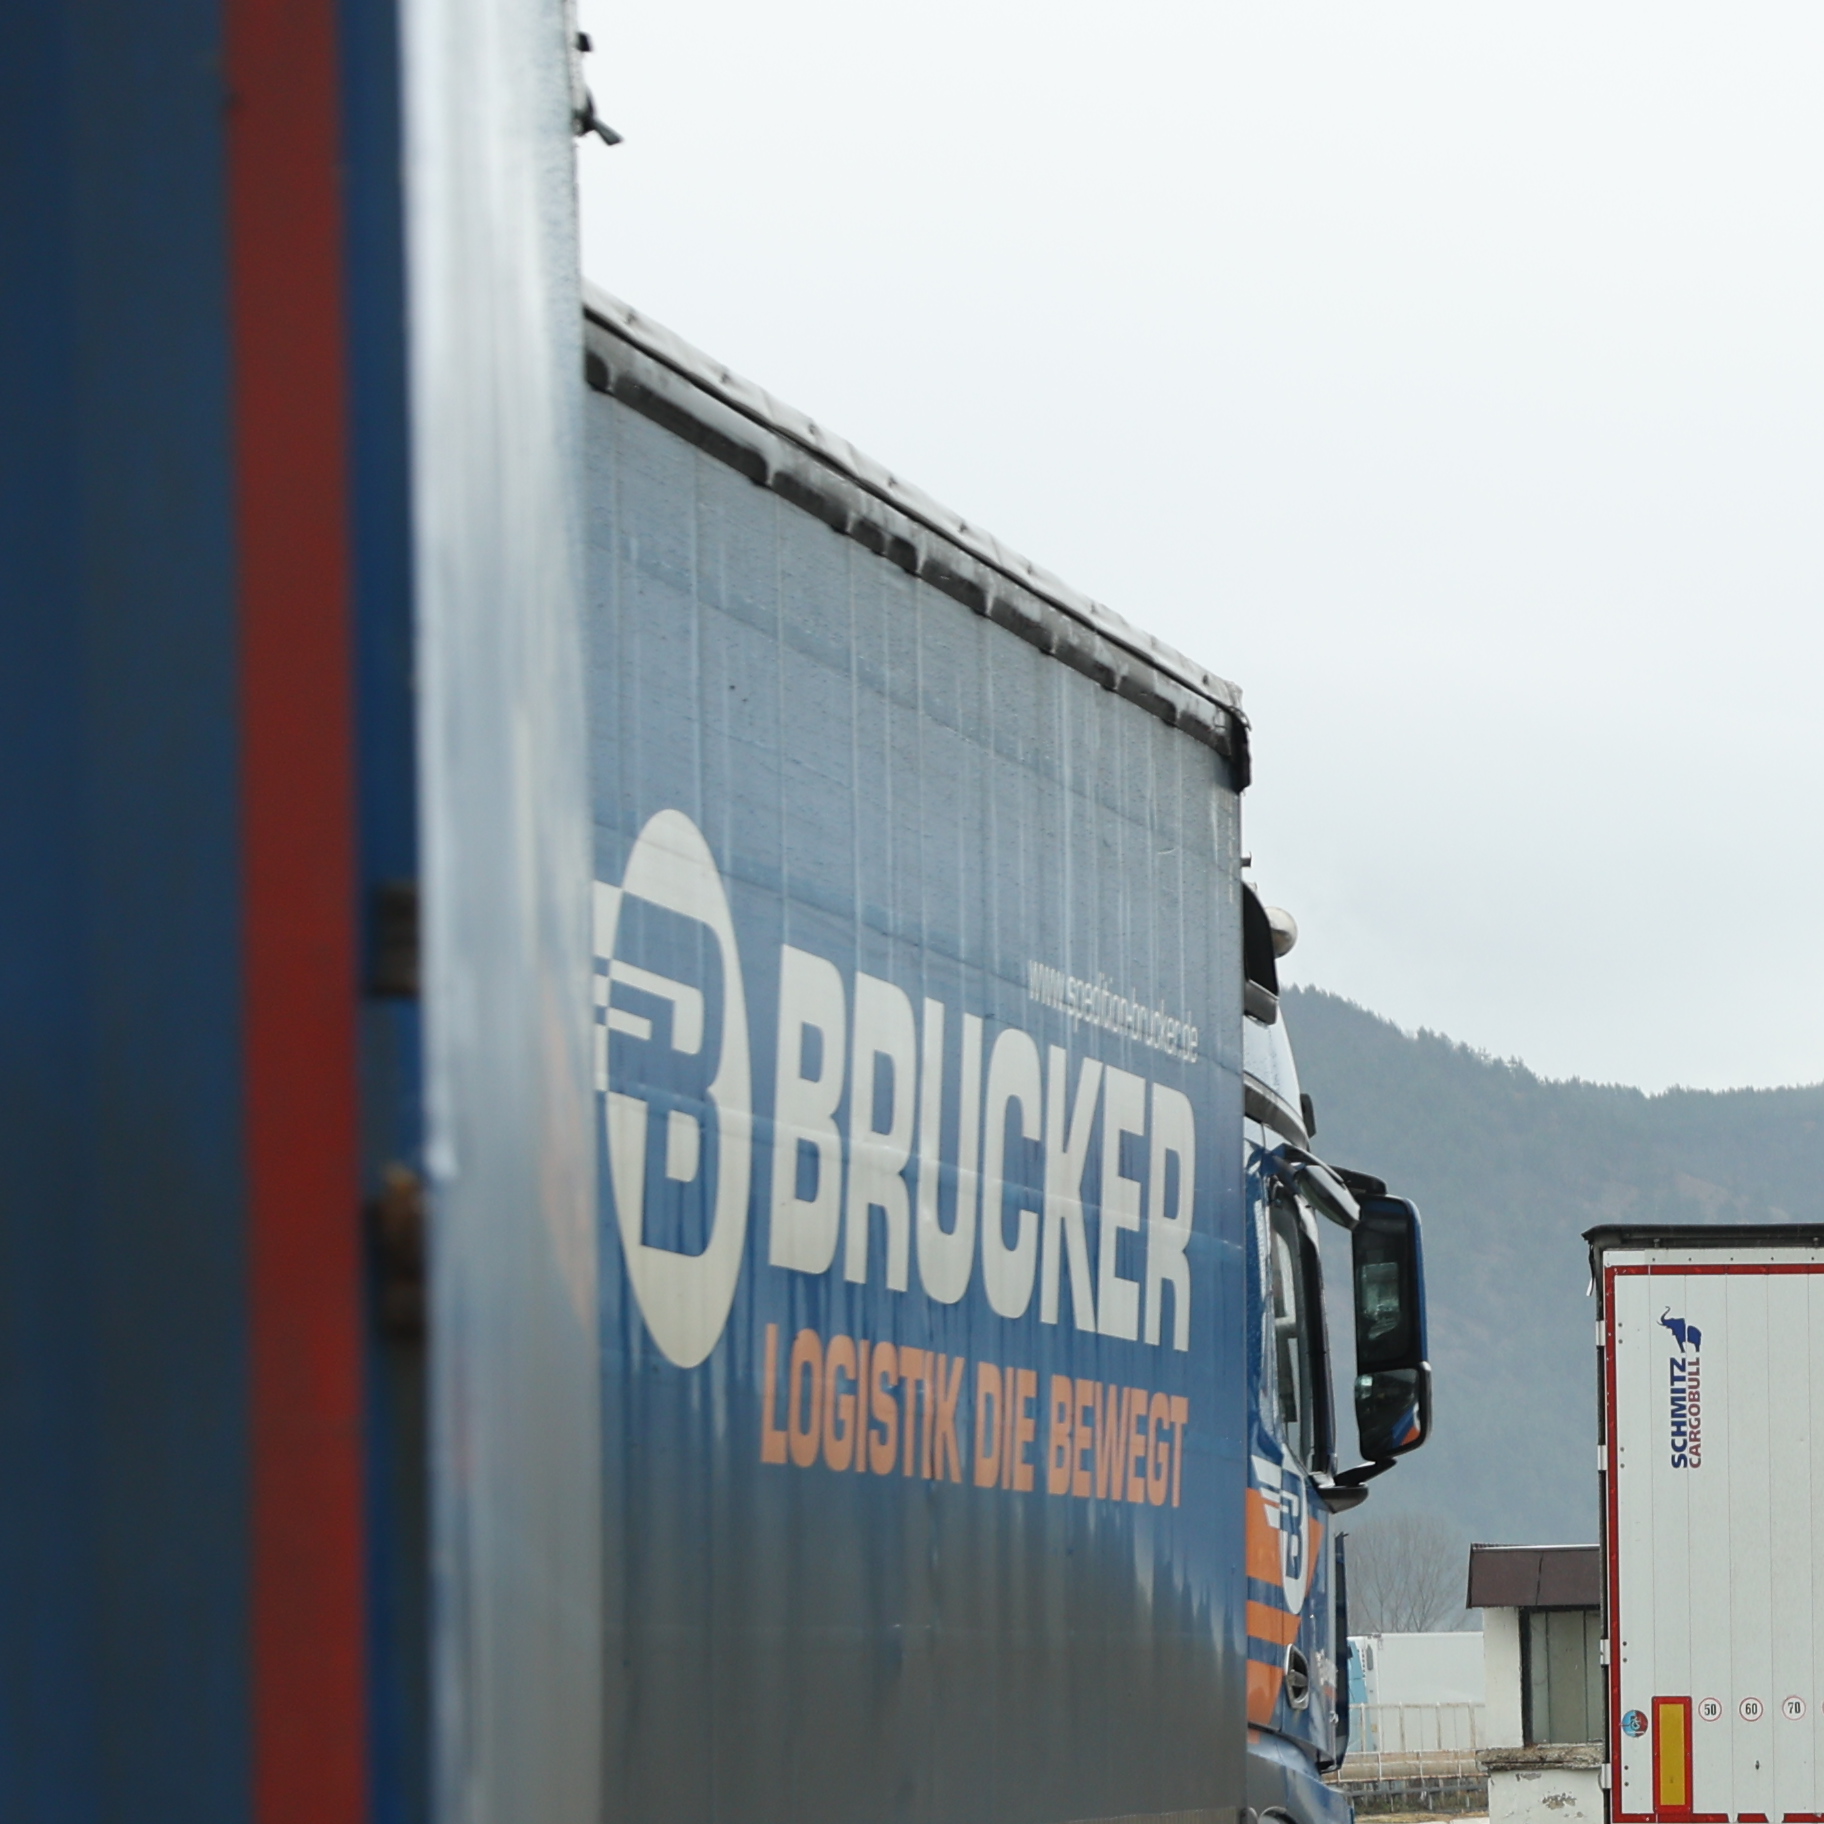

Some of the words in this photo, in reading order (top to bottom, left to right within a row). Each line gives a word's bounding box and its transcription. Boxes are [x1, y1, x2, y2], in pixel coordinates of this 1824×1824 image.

[769, 944, 1196, 1353] BRUCKER
[760, 1323, 965, 1484] LOGISTIK
[974, 1361, 1037, 1492] DIE
[1047, 1374, 1189, 1508] BEWEGT
[1669, 1357, 1688, 1469] SCHMITZ
[1687, 1357, 1702, 1469] CARGOBULL
[1704, 1703, 1717, 1716] 50
[1745, 1703, 1758, 1715] 60
[1787, 1701, 1801, 1714] 70
